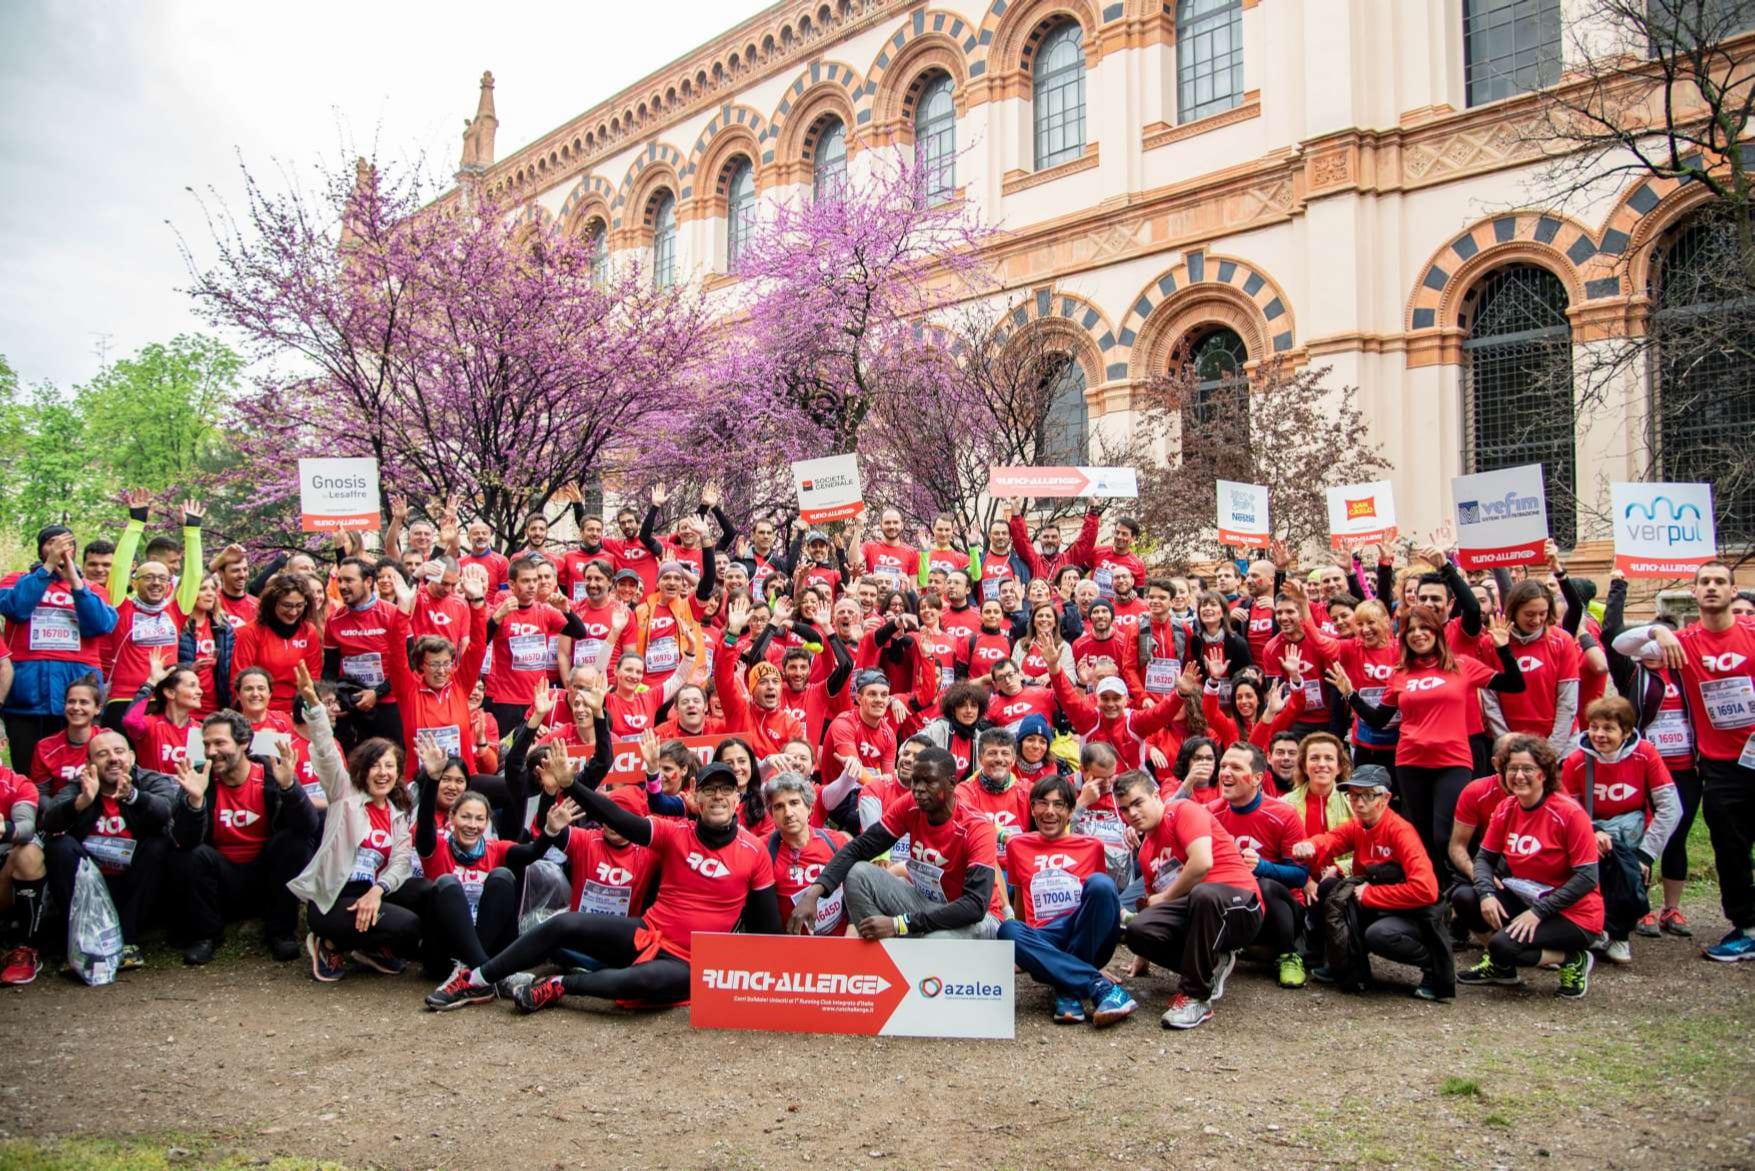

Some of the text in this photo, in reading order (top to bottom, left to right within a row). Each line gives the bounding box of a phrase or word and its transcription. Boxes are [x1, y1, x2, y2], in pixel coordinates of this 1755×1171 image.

[313, 474, 367, 489] Gnosis
[1481, 491, 1539, 516] vefim
[1626, 520, 1703, 547] verpul
[510, 622, 535, 636] RC
[947, 626, 966, 637] RC
[1250, 619, 1271, 631] RC
[978, 647, 1000, 659] RC
[1702, 653, 1731, 672] RC
[1364, 663, 1387, 679] RC
[1406, 677, 1433, 691] RC
[1003, 703, 1023, 716] RC
[1717, 703, 1745, 716] 1691A
[1658, 733, 1684, 744] 1691D
[1593, 783, 1623, 800] RC
[220, 809, 247, 827] RC
[1507, 833, 1533, 854] RC
[912, 841, 936, 865] RC
[687, 852, 716, 878] RC
[1034, 854, 1064, 870] RC
[596, 861, 621, 885] RC
[790, 864, 818, 885] RC
[1042, 890, 1072, 905] 1700A
[702, 969, 877, 995] RUNCHALLENGE
[945, 980, 1002, 996] azalea
